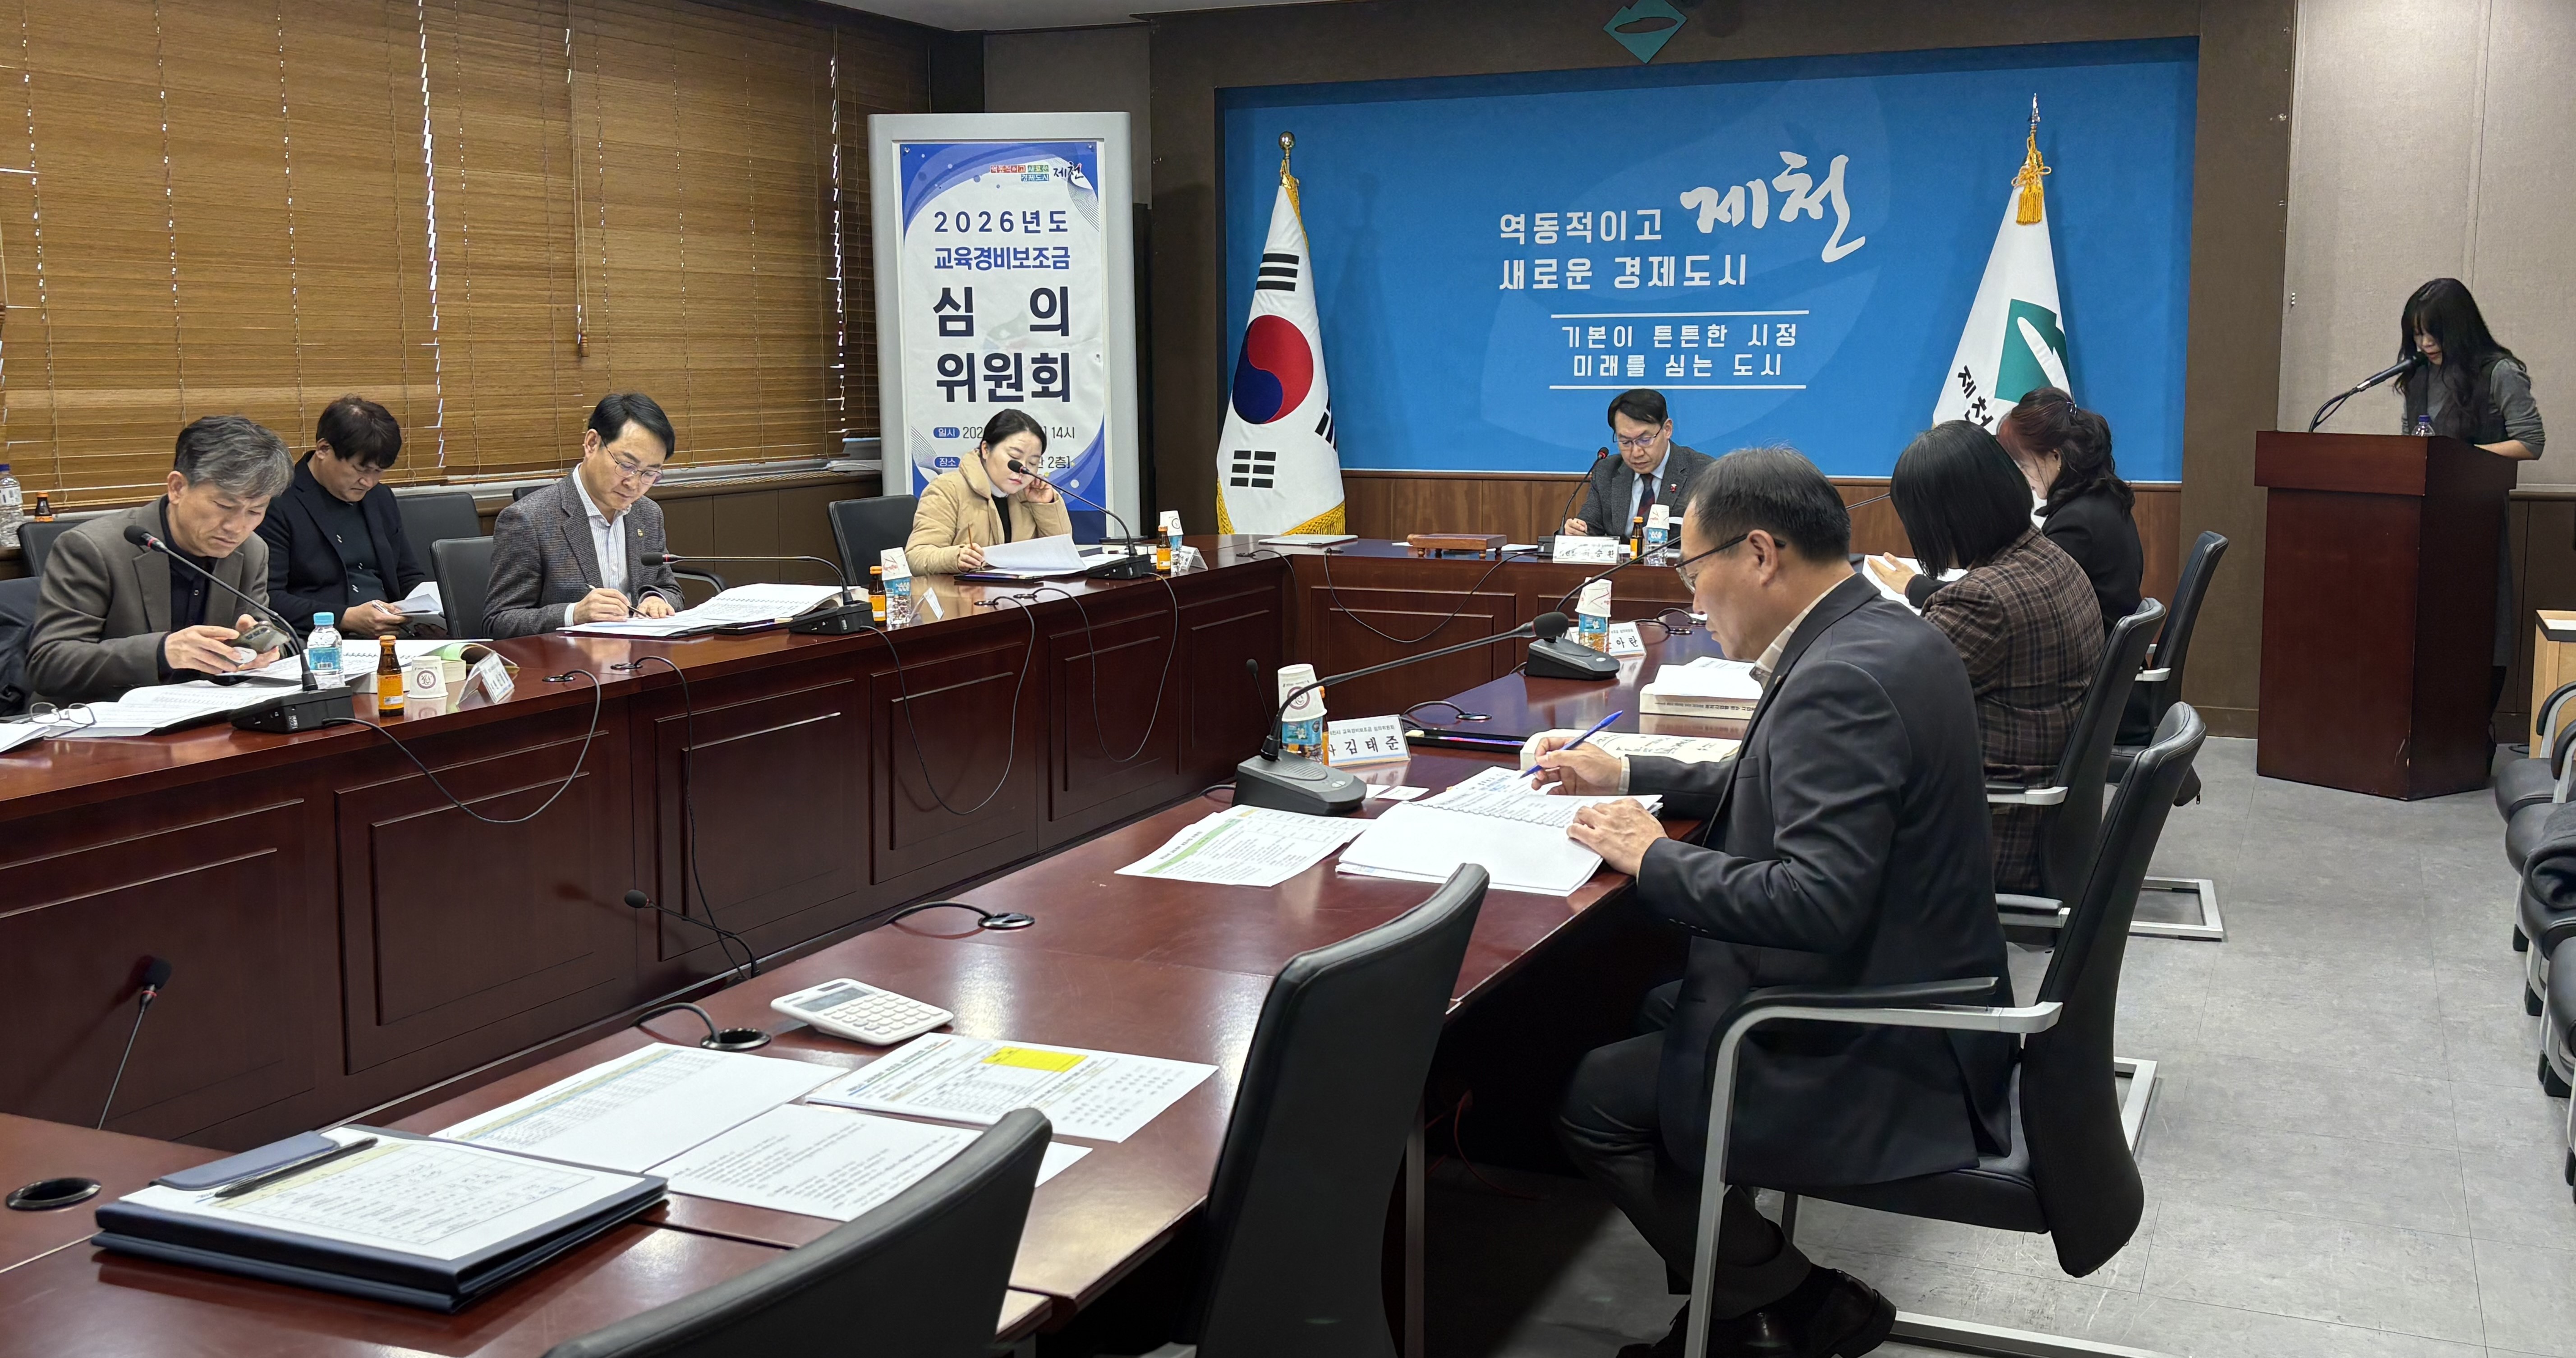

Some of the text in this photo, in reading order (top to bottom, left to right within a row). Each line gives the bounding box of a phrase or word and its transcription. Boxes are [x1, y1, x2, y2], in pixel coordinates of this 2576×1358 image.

[1680, 152, 1866, 263] 제천
[934, 211, 1068, 234] 2026년도
[1500, 209, 1661, 245] 역동적이고
[934, 247, 1070, 271] 교육경비보조금
[1500, 254, 1746, 290] 새로운 경제도시
[1562, 324, 1797, 348] 기본이 튼튼한 시정
[937, 353, 1070, 402] 위원회
[1574, 354, 1781, 377] 미래를 심는 도시
[938, 428, 956, 437] 일시
[963, 427, 984, 439] 202
[1052, 427, 1075, 439] 14시
[939, 458, 957, 467] 장소
[1048, 456, 1070, 469] 2층]
